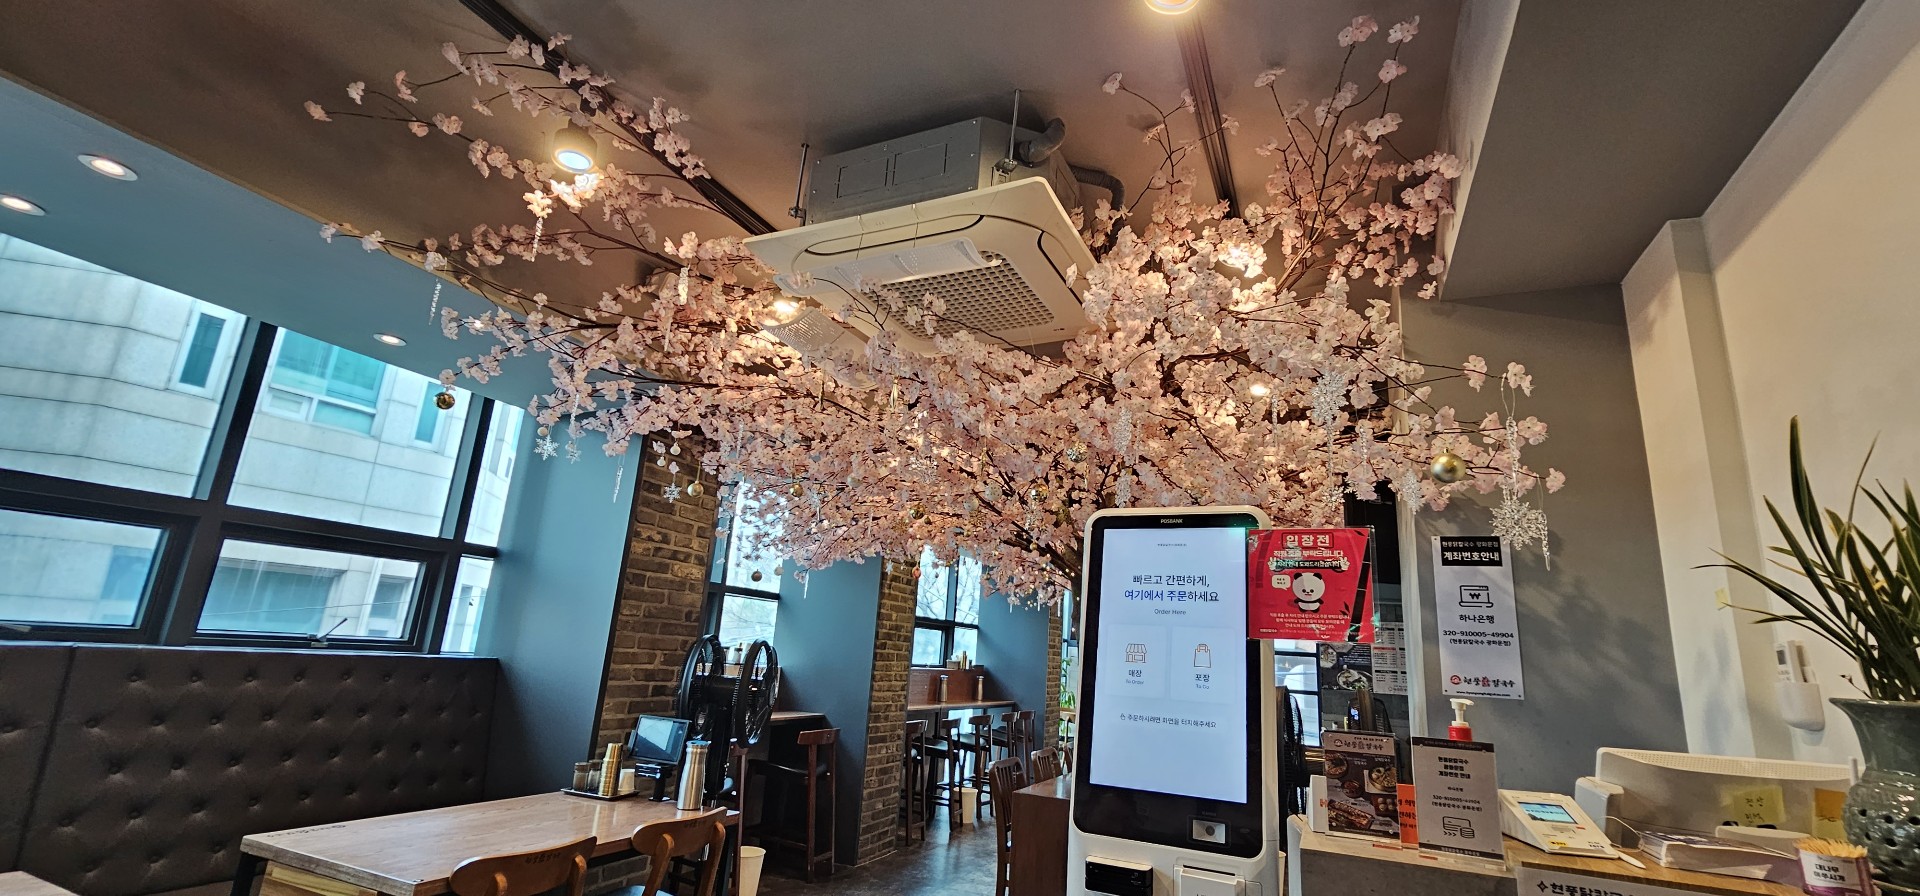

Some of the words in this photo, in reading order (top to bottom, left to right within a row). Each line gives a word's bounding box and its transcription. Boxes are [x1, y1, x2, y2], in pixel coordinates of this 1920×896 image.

[1443, 551, 1500, 561] 계좌번호안내
[1132, 574, 1163, 586] 빠르고
[1165, 574, 1210, 588] 간편하게,
[1124, 589, 1164, 601] 여기에서
[1166, 589, 1219, 602] 주문하세요
[1459, 614, 1495, 624] 하나은행
[1443, 630, 1514, 639] 320-910005-49904
[1128, 669, 1142, 677] 매장
[1195, 674, 1210, 682] 포장
[1127, 714, 1161, 724] 주문하시려면
[1162, 717, 1180, 726] 화면을
[1181, 719, 1217, 728] 터치해주세요
[1550, 882, 1634, 896] 현풍닭칼
